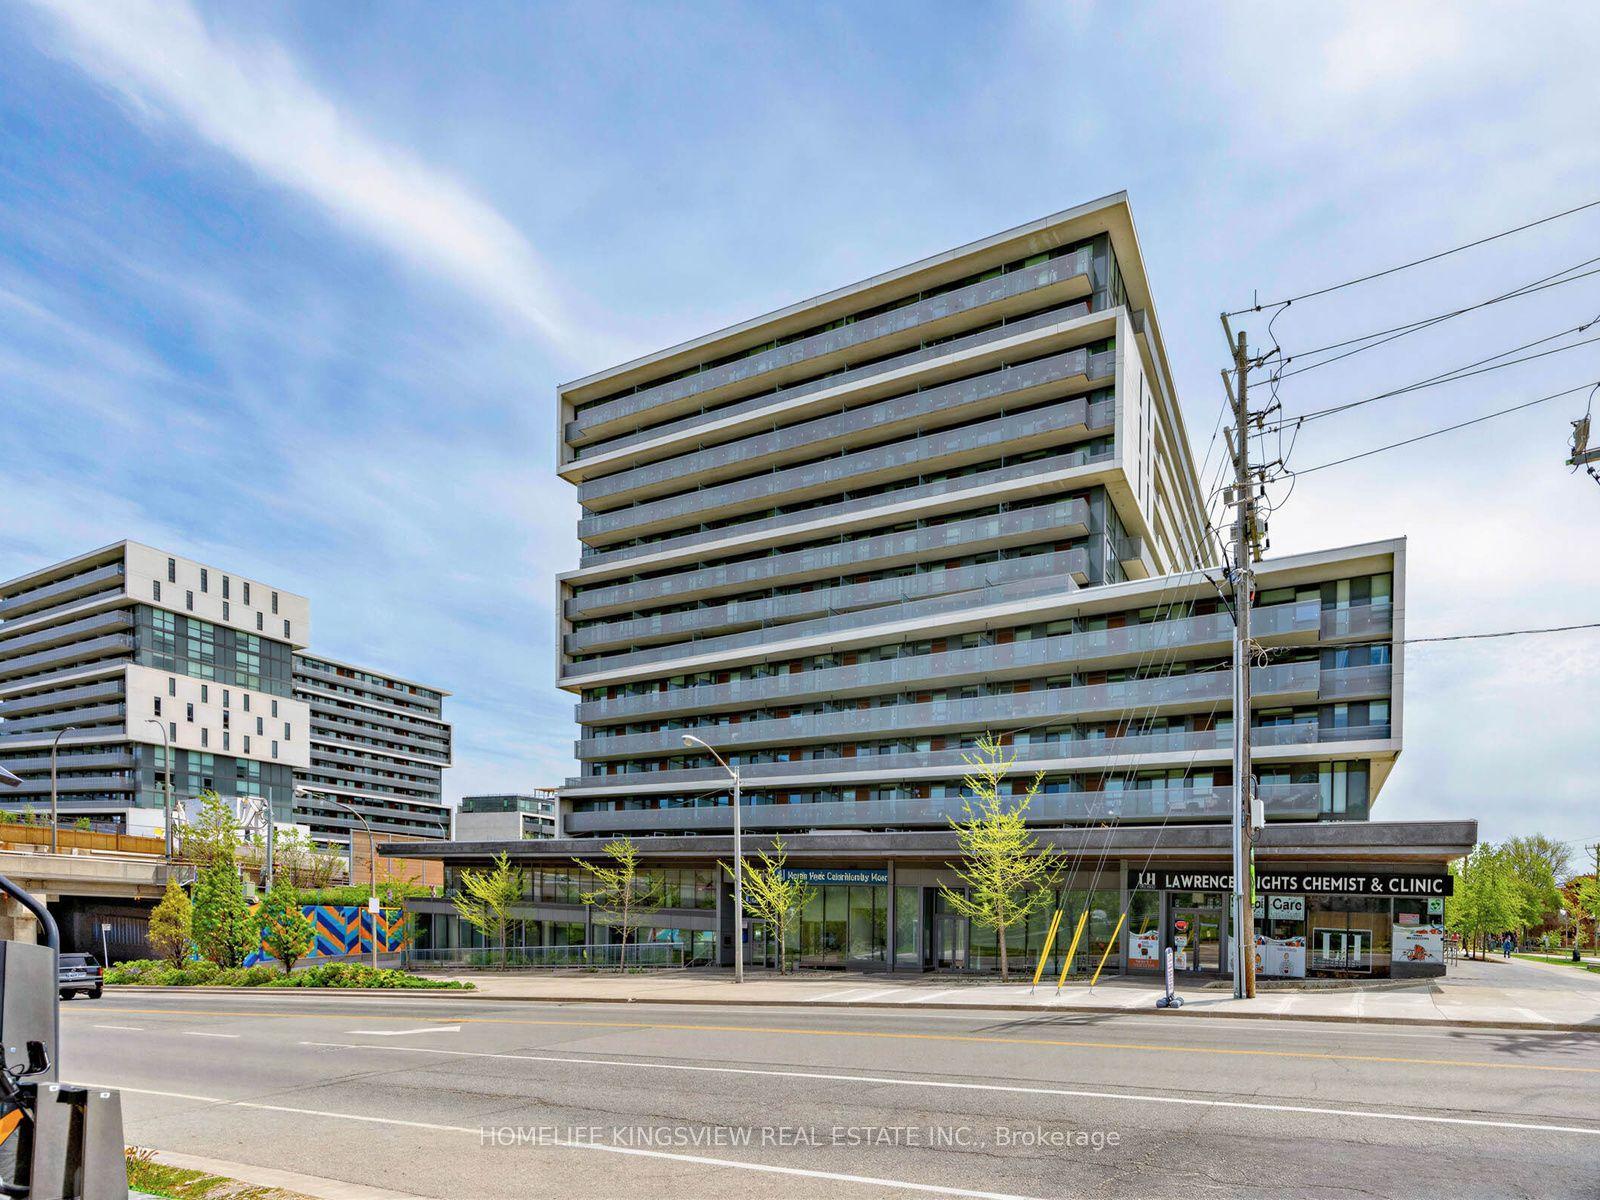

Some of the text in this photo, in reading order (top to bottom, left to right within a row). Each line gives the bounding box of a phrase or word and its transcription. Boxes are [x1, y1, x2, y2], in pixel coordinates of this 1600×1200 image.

[1165, 874, 1444, 894] LAWRENCE IGHTS CHEMIST & CLINIC
